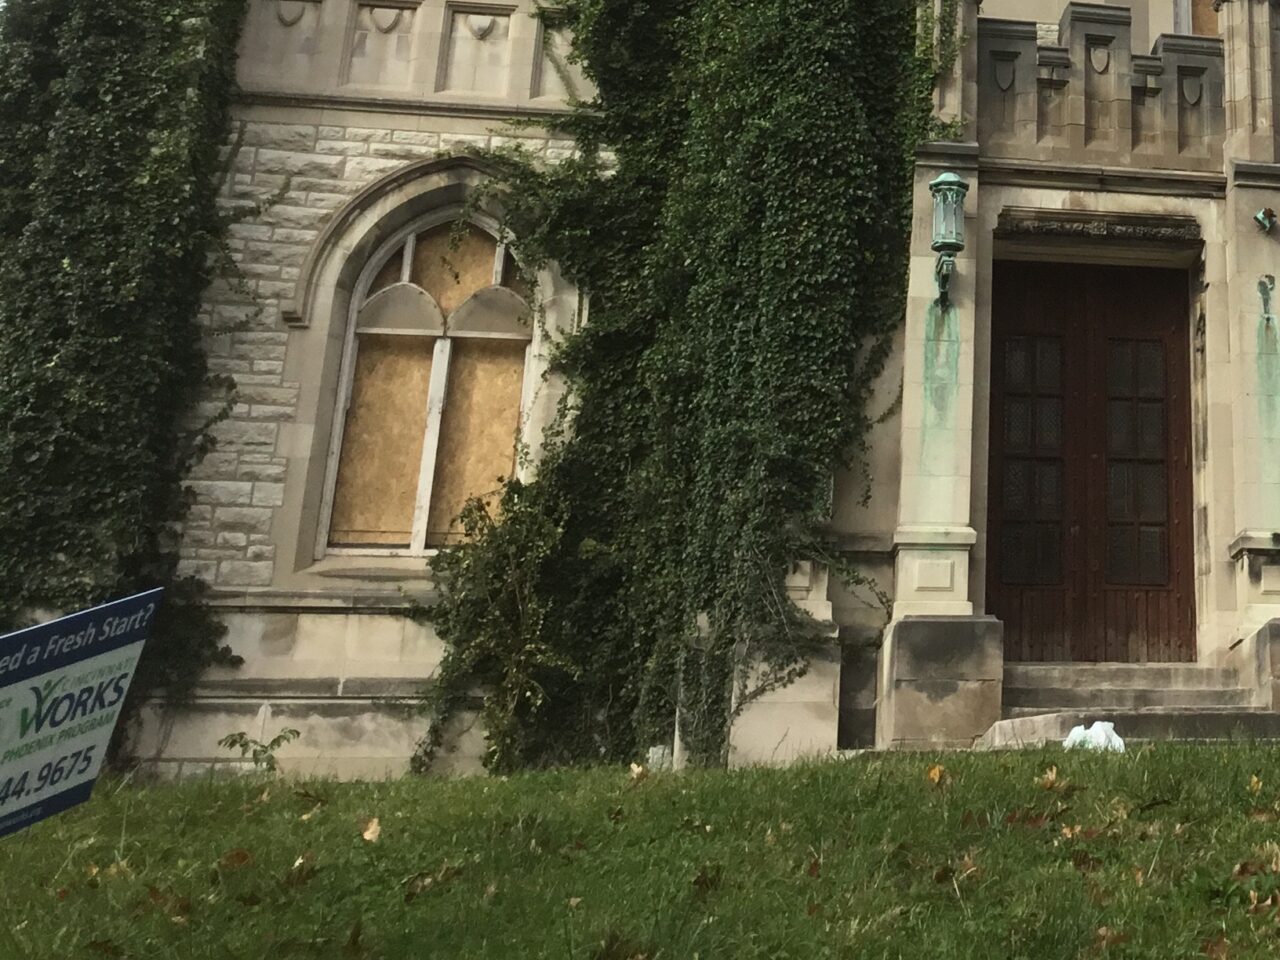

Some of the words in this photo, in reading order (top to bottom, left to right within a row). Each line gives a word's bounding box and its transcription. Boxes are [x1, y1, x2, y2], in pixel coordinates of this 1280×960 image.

[26, 646, 41, 666] a
[43, 622, 96, 660] Fresh
[98, 602, 155, 642] Start?
[57, 710, 117, 743] PROGRAM
